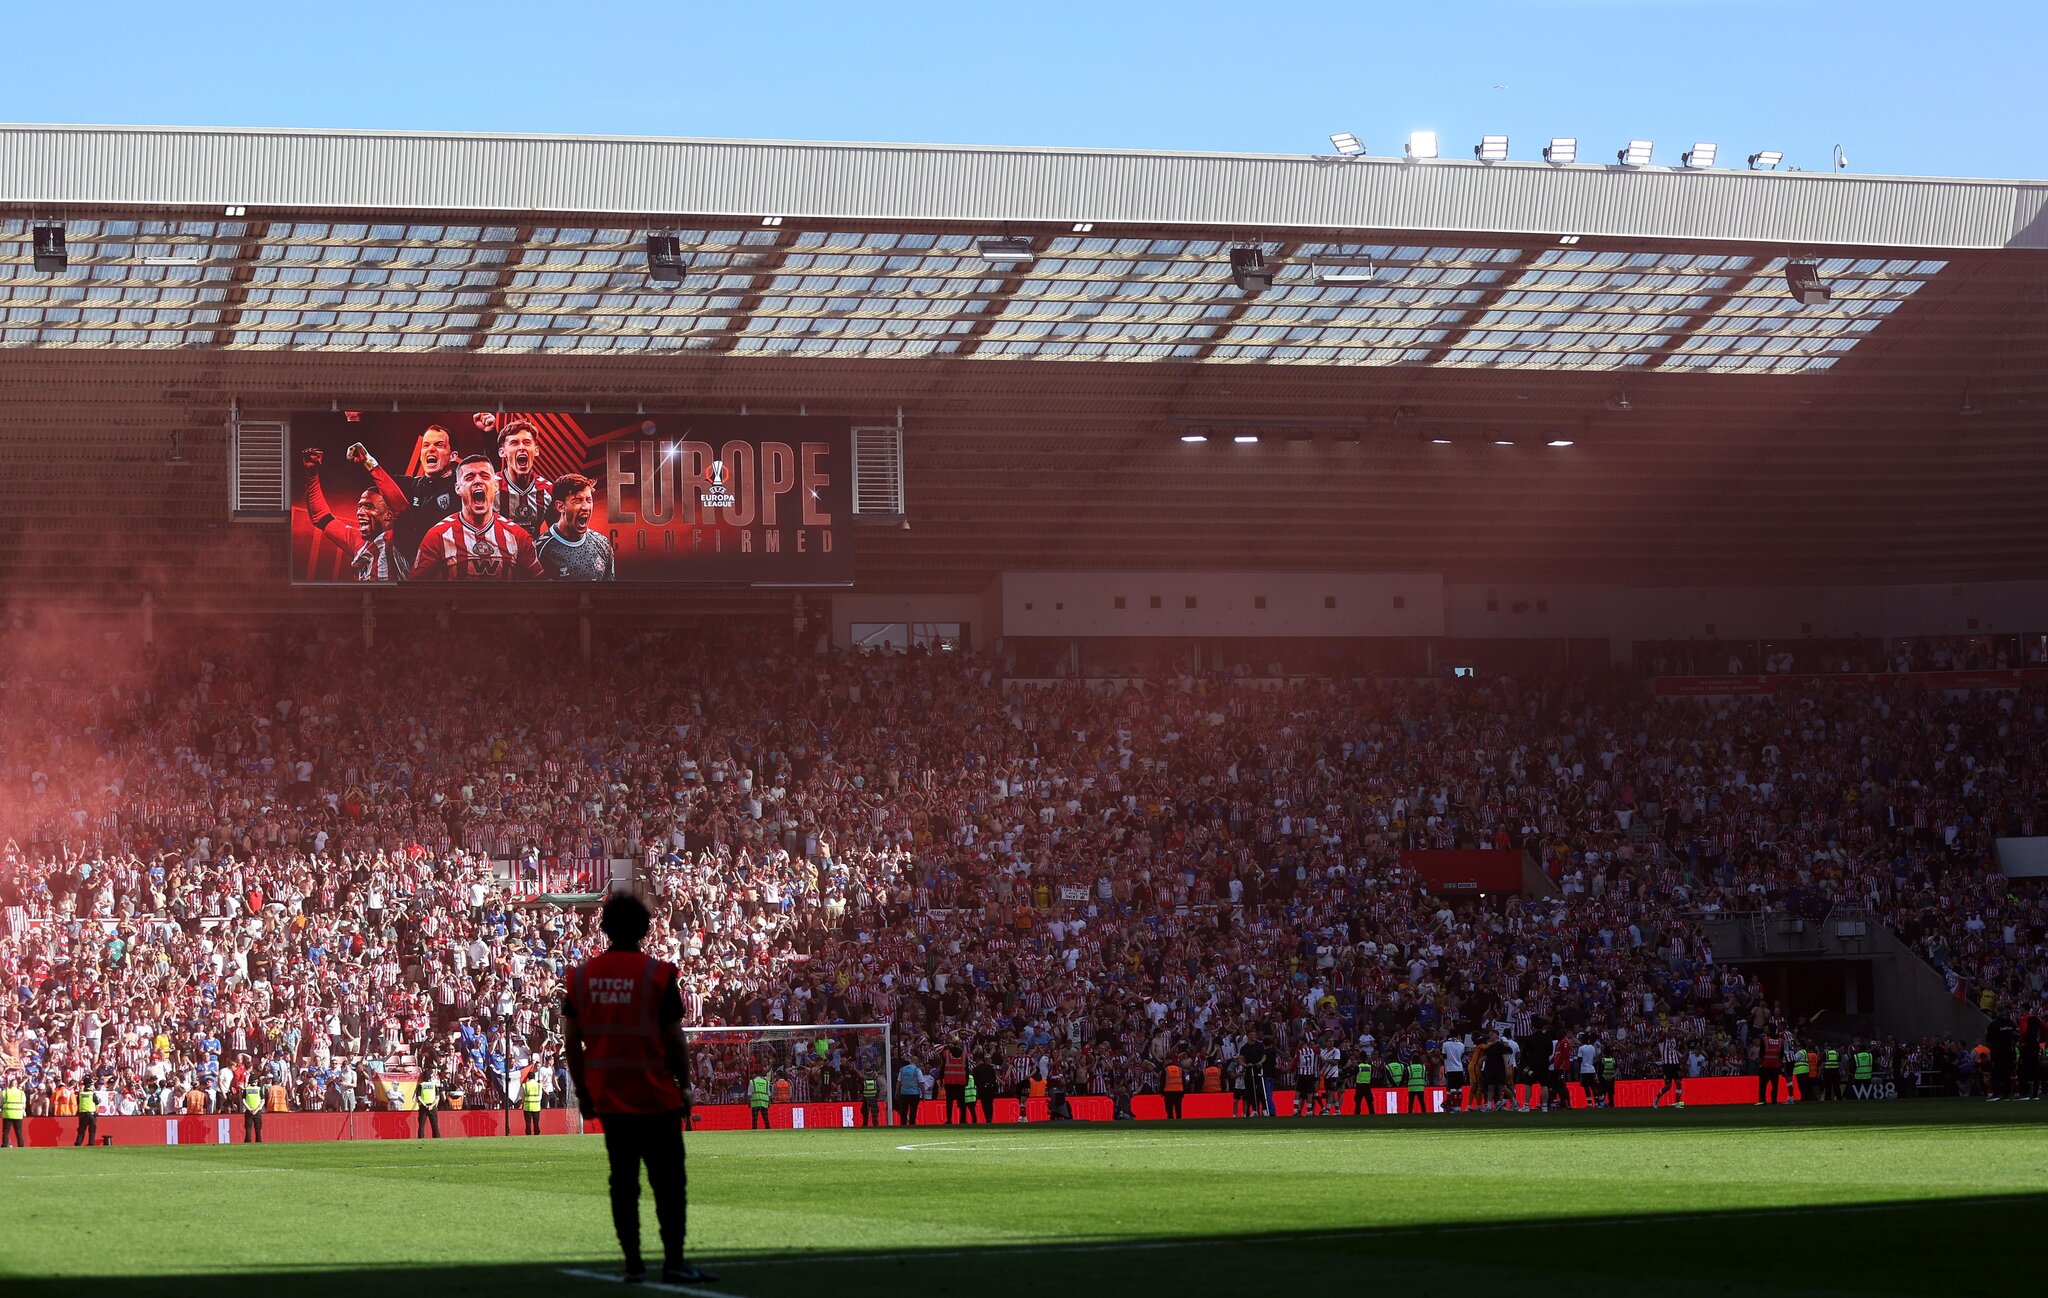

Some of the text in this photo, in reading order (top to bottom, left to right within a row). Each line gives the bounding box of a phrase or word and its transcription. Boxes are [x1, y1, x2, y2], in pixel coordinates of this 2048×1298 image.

[605, 439, 832, 527] EUROPE
[701, 494, 735, 502] EUROPA
[608, 528, 833, 553] CONFIRMED
[588, 978, 634, 991] PITCH
[590, 991, 632, 1004] TEAM
